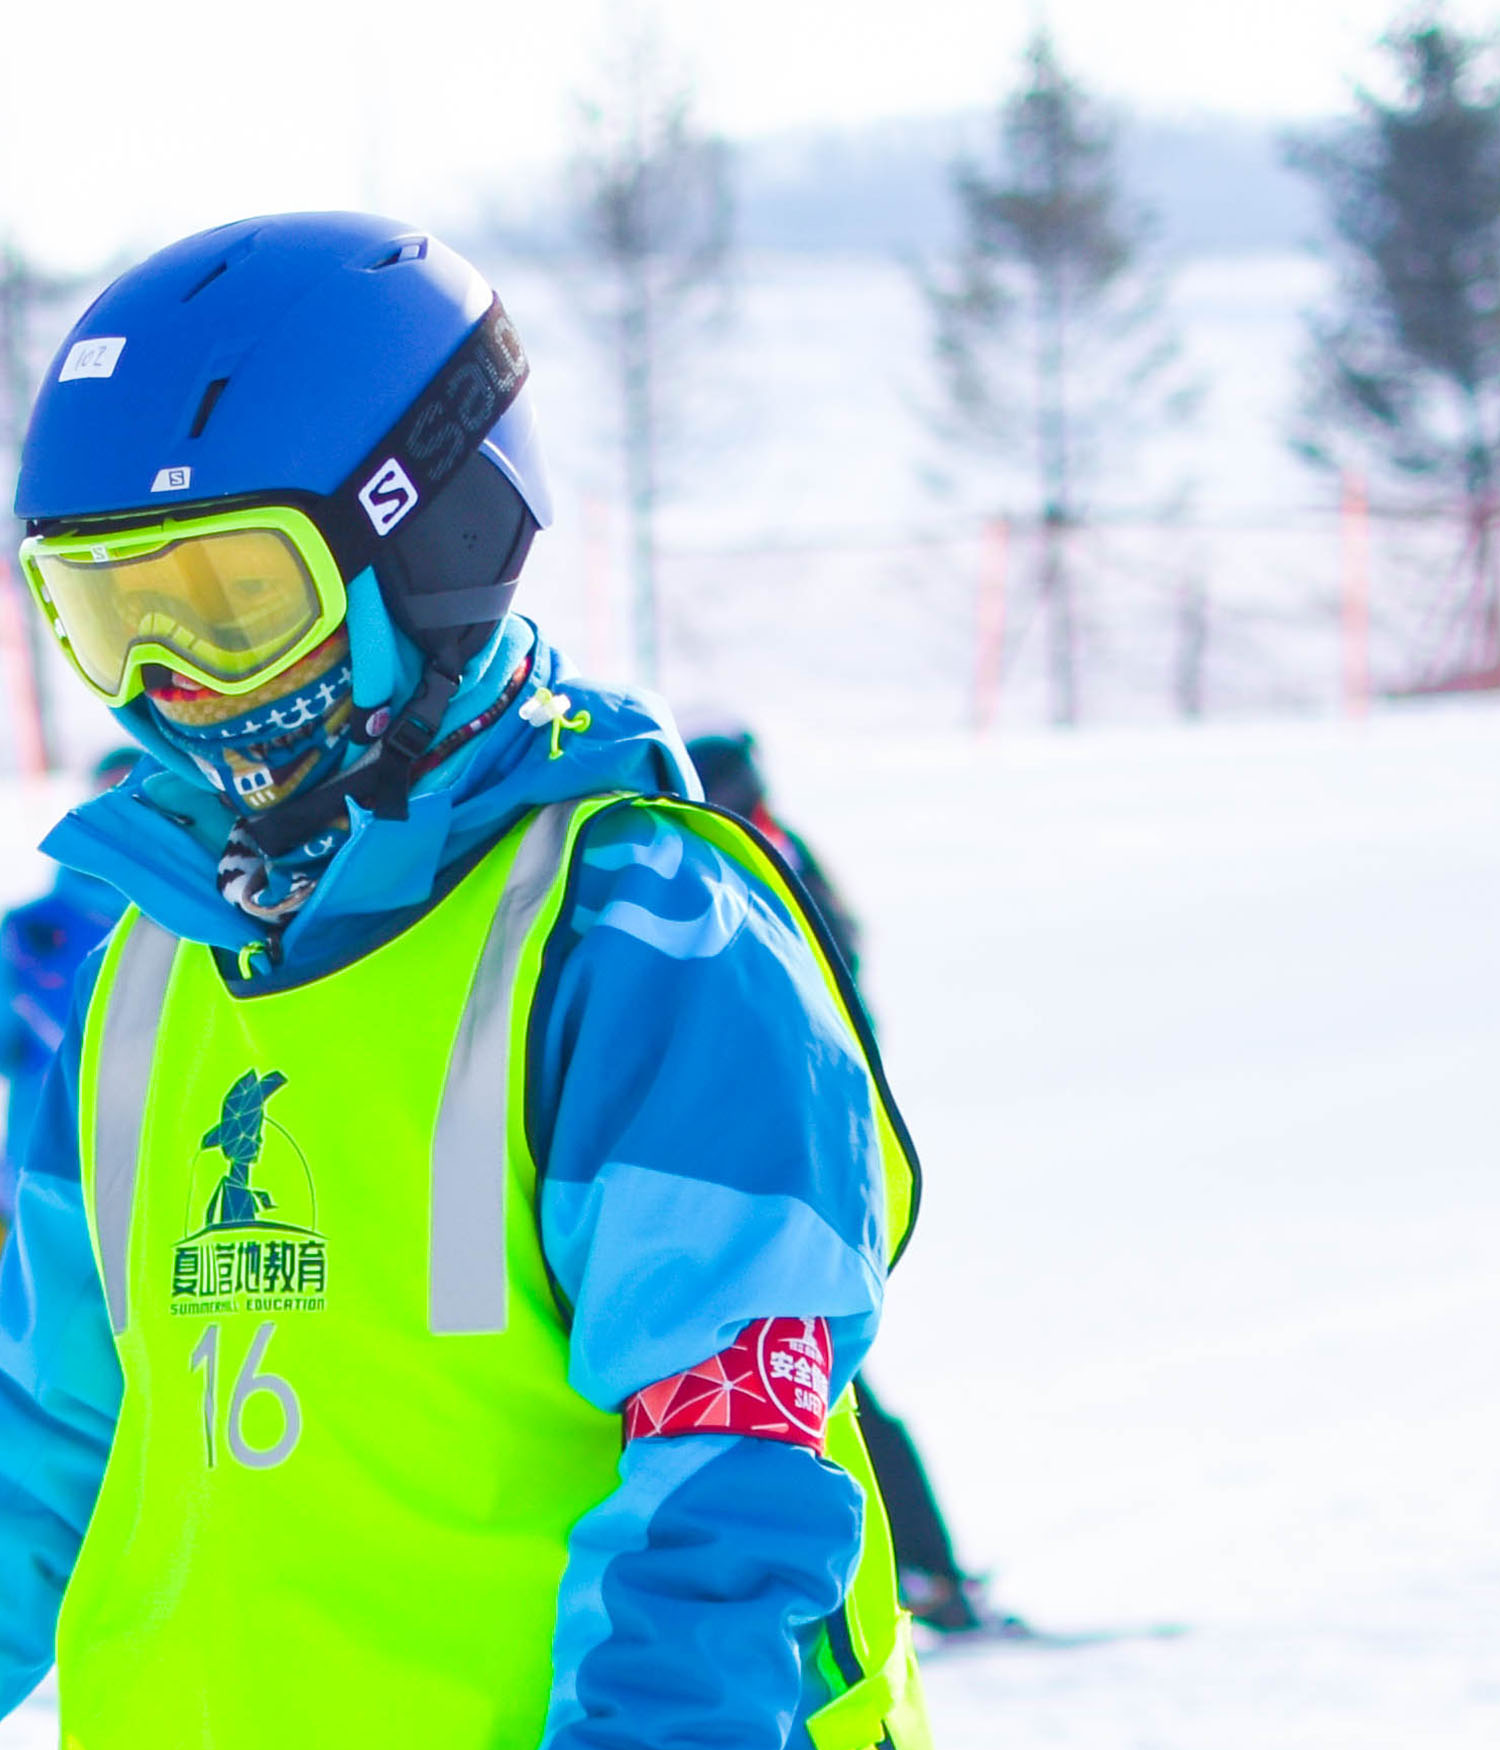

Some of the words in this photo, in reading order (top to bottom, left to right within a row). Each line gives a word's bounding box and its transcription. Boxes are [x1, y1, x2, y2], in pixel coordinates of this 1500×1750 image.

[171, 1241, 325, 1297] 夏山营地教育
[246, 1298, 325, 1312] EDUCATION
[190, 1322, 302, 1470] 16
